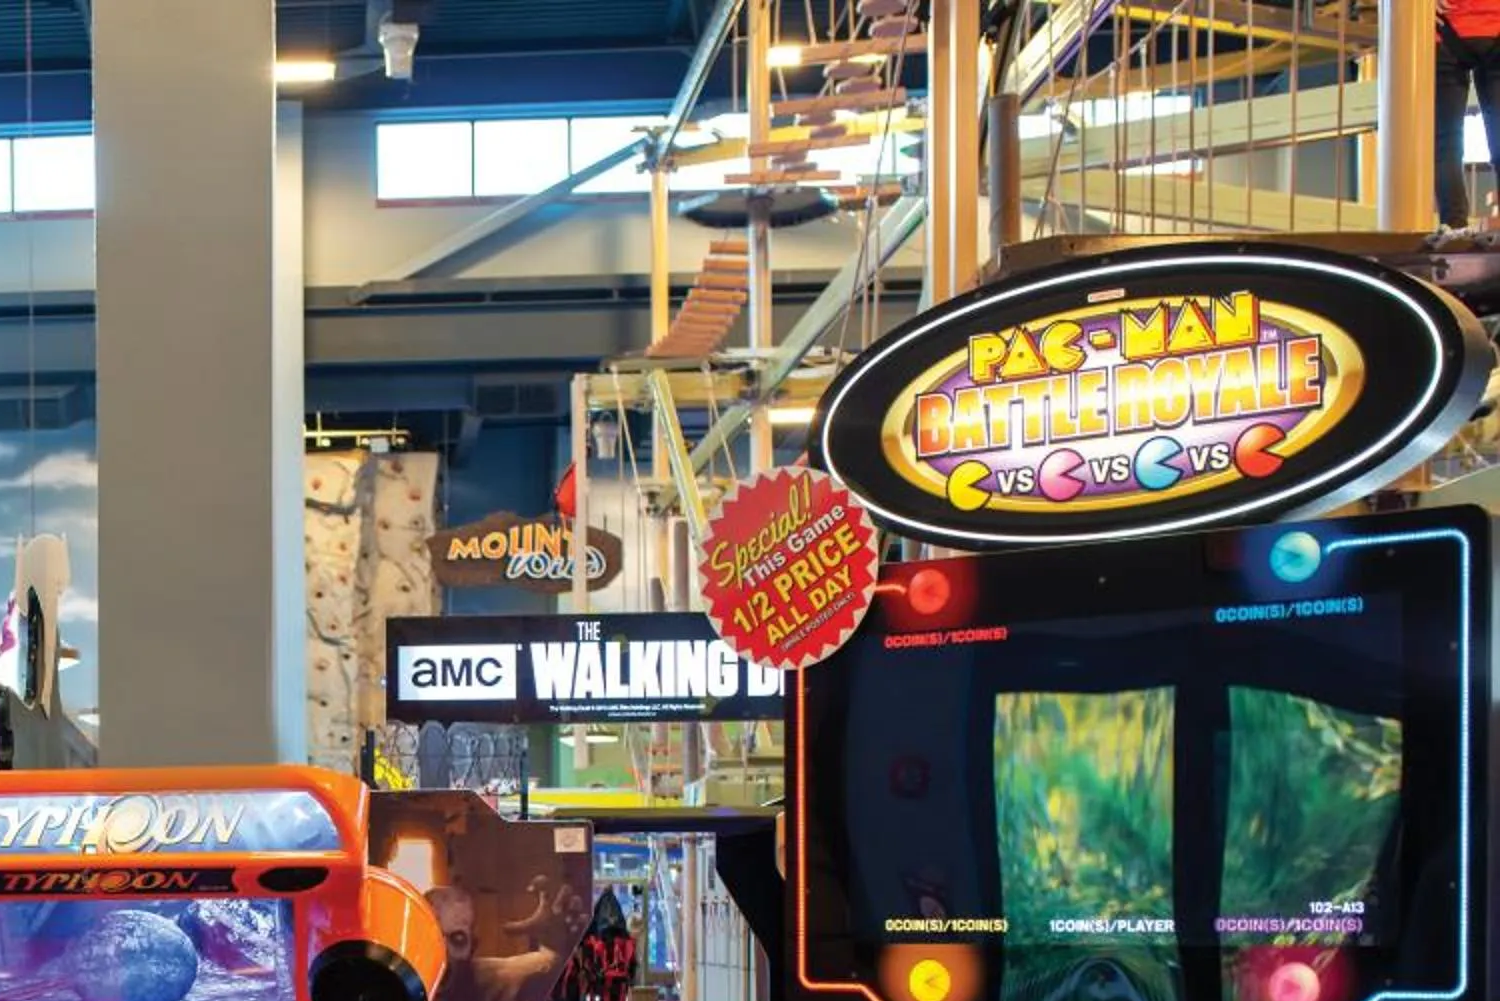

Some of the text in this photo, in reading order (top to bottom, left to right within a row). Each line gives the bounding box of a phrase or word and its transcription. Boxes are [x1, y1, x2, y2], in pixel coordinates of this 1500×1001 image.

[968, 289, 1260, 386] PAC-MAN
[916, 334, 1323, 459] BATTLE ROYALE
[998, 443, 1230, 493] VS VS VS
[710, 470, 812, 590] Special!
[743, 505, 846, 588] This Game
[733, 522, 861, 633] 1/2 PRICE
[766, 565, 853, 646] ALL DAY
[530, 639, 740, 699] WALKING
[576, 621, 601, 641] THE
[2, 868, 198, 893] TYPHOON
